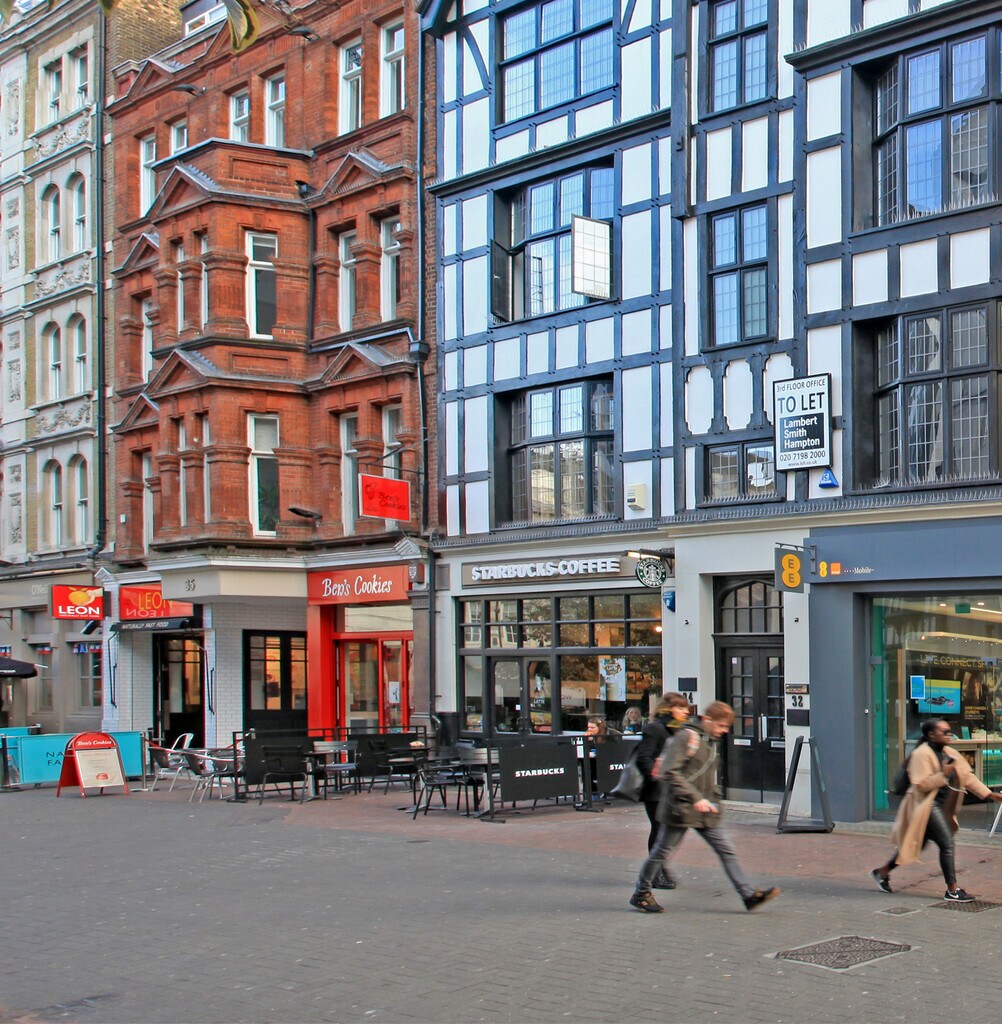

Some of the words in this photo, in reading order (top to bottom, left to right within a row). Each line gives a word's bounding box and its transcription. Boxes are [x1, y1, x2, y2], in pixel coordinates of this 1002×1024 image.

[787, 381, 805, 391] FLOOR
[806, 379, 826, 388] OFFICE
[777, 396, 796, 414] TO
[801, 392, 825, 411] LET
[784, 416, 818, 429] Lambert
[784, 428, 807, 439] Smith
[784, 438, 820, 449] Hampton
[793, 452, 809, 460] 7198
[810, 450, 826, 458] 2000
[472, 560, 555, 581] STARBUCKS
[558, 557, 621, 576] COFFEE
[185, 579, 196, 592] 35
[322, 578, 350, 596] Ben's
[354, 574, 392, 595] Cookies
[58, 606, 100, 615] LEON
[940, 656, 976, 667] CONNECT
[792, 695, 803, 707] 32
[515, 767, 565, 777] STARBUCKS
